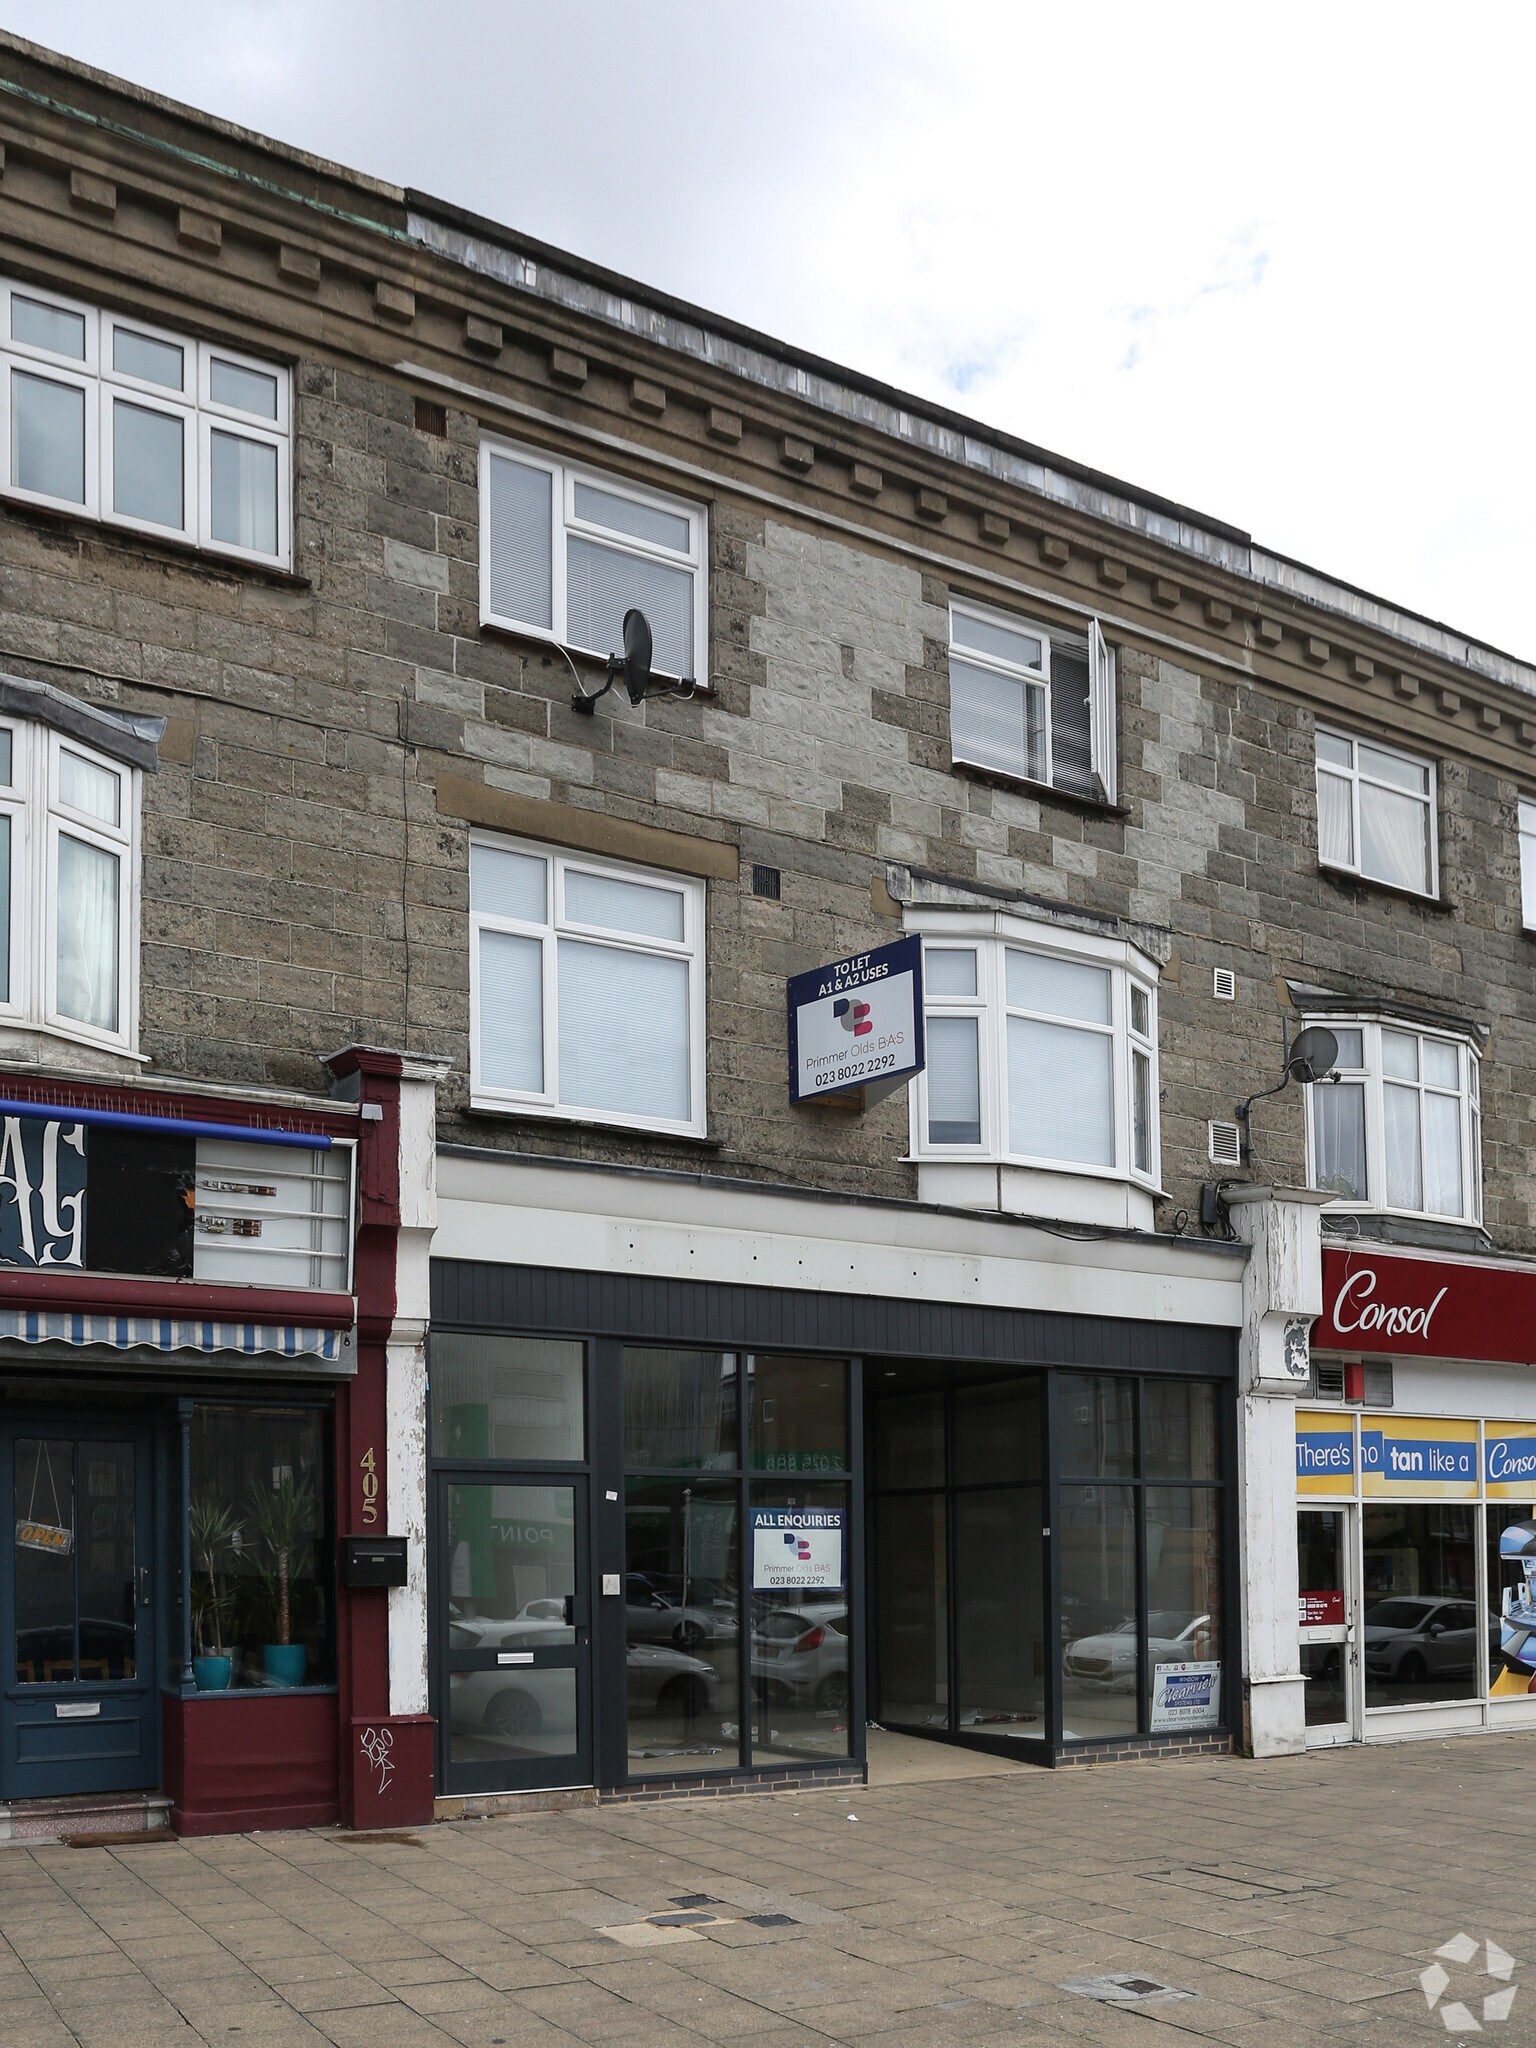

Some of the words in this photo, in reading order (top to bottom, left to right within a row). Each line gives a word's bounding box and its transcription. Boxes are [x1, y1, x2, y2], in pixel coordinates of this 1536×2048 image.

[818, 981, 833, 996] A1
[834, 979, 843, 991] &
[844, 973, 860, 988] A2
[861, 963, 889, 982] USES
[834, 962, 850, 977] TO
[851, 954, 871, 971] LET
[806, 1050, 848, 1070] Primmer
[850, 1041, 875, 1057] Olds
[815, 1070, 836, 1087] 023
[837, 1062, 865, 1080] 8022
[867, 1053, 895, 1073] 2292
[1333, 1269, 1449, 1340] Consol
[1296, 1442, 1350, 1467] There's
[1391, 1446, 1423, 1472] tan
[1429, 1448, 1455, 1472] like
[1459, 1456, 1469, 1472] a
[360, 1447, 379, 1524] 405
[755, 1514, 776, 1526] ALL
[778, 1514, 841, 1528] ENQUIRIES
[21, 1525, 65, 1548] OPEN
[763, 1564, 794, 1573] Primmer
[770, 1577, 785, 1585] 023
[786, 1576, 806, 1584] 8022
[807, 1576, 825, 1584] 2292
